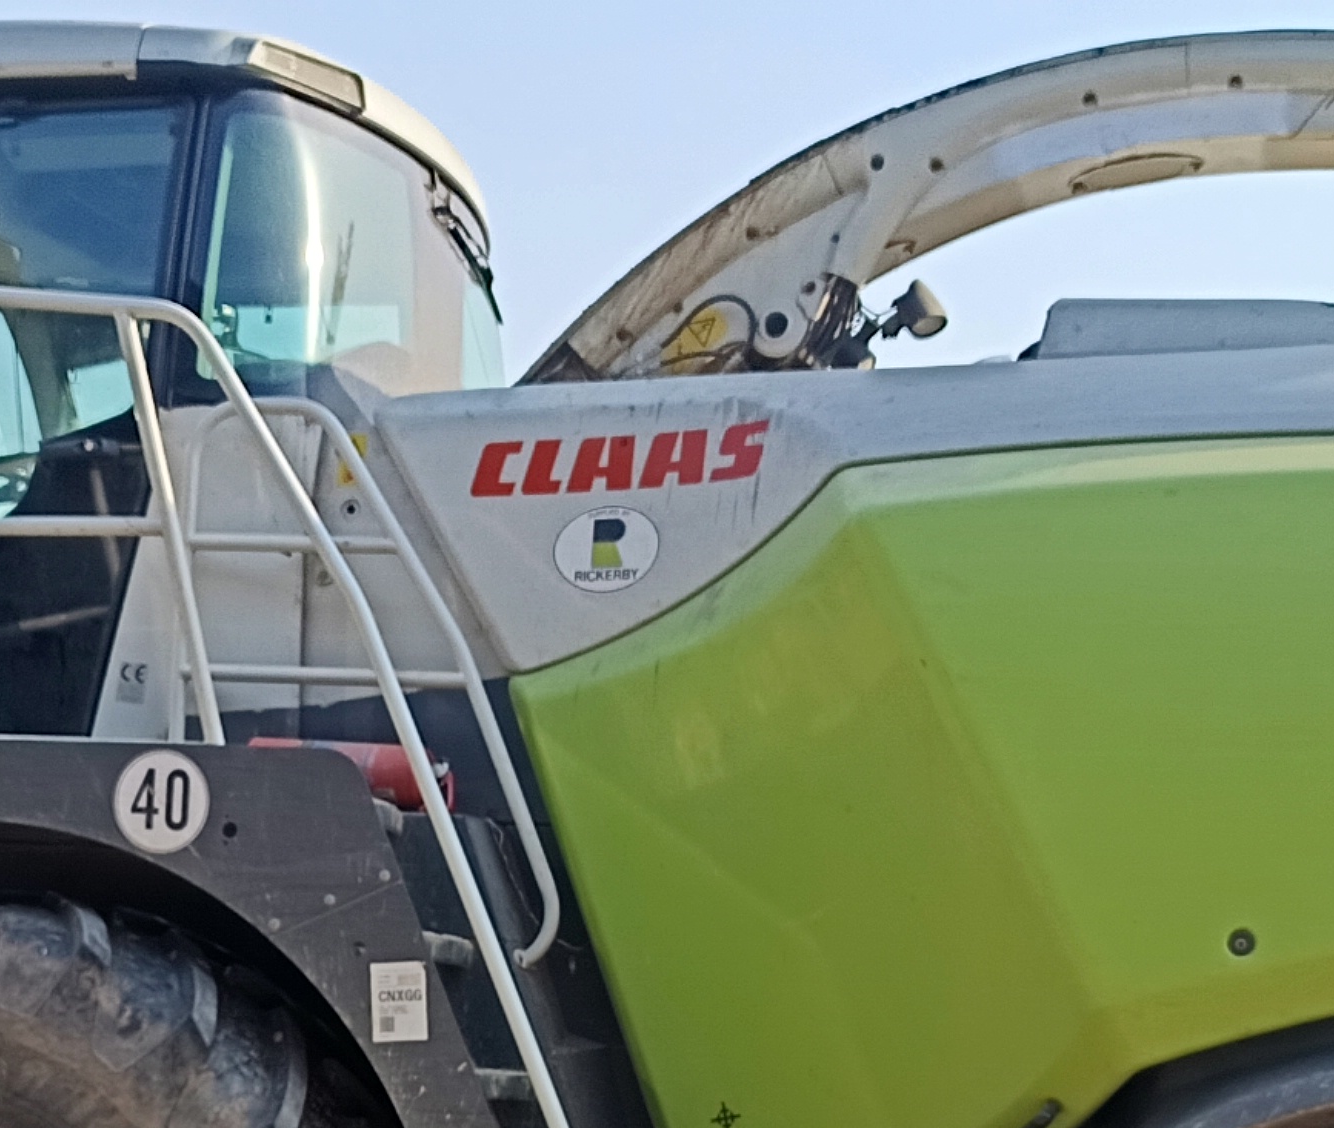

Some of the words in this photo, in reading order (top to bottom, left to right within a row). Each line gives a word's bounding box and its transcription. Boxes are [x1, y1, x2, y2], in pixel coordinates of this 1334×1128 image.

[470, 419, 770, 497] CLAAS
[574, 569, 639, 582] RICKERBY
[120, 662, 147, 684] CE
[131, 768, 190, 831] 40
